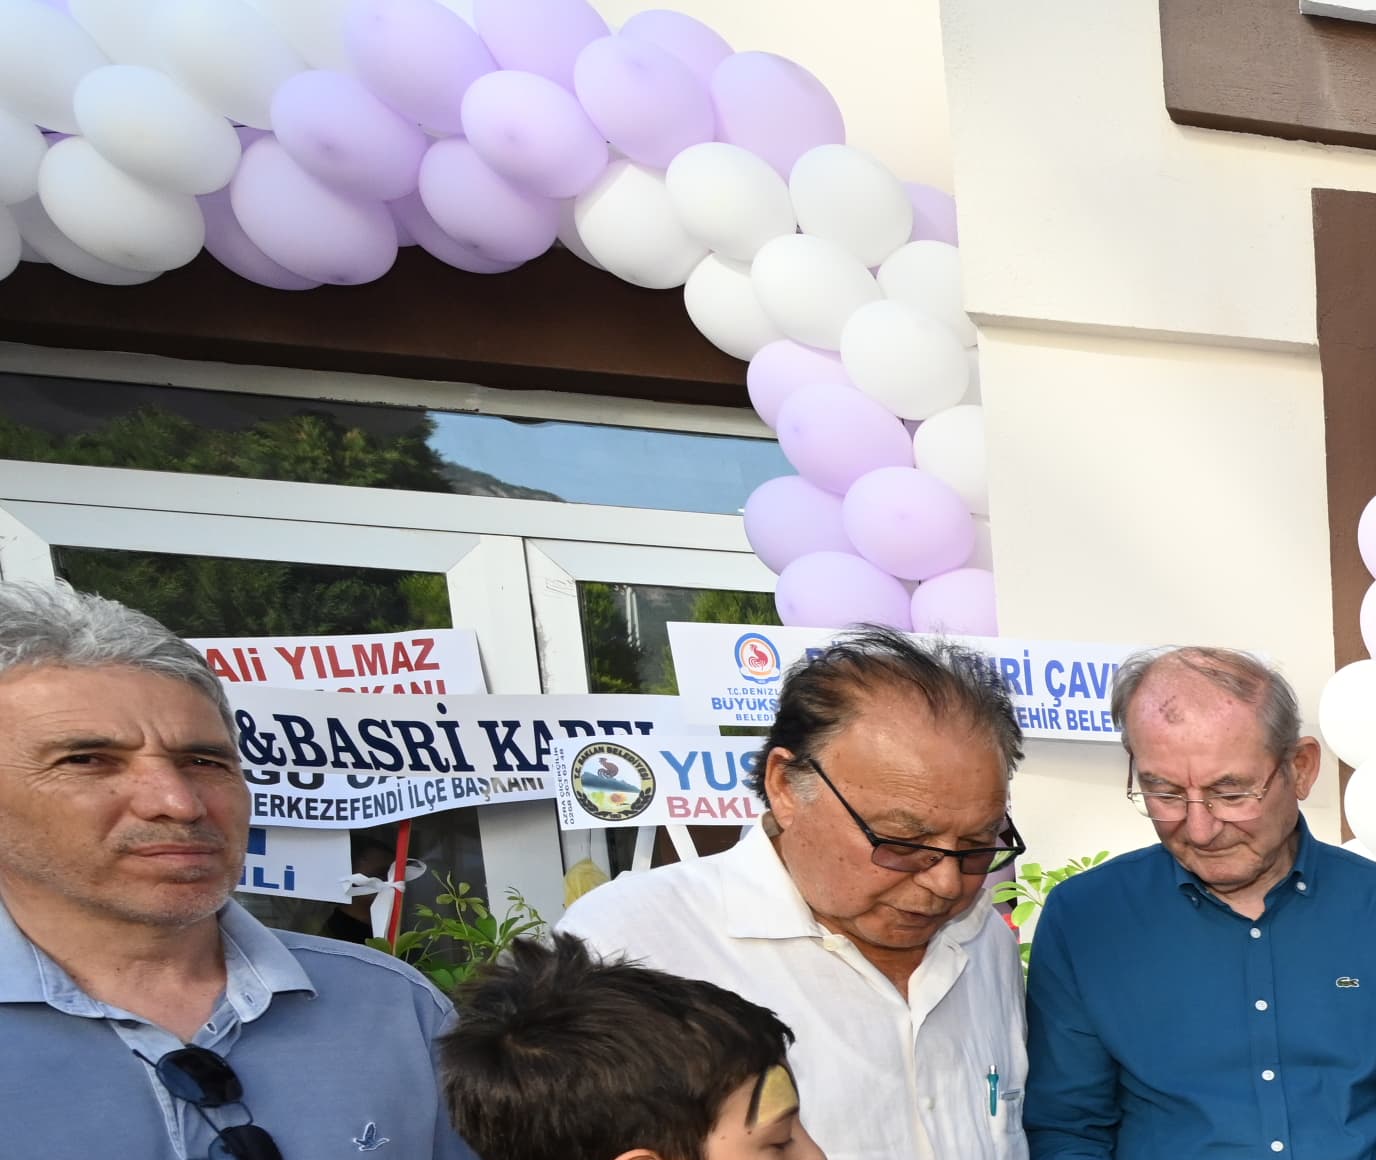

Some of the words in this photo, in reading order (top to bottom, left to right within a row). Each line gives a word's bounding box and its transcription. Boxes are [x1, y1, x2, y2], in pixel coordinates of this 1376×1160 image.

[274, 638, 440, 681] YILMAZ
[1044, 660, 1118, 707] ÇAV
[235, 702, 475, 773] &BASRİ
[1066, 709, 1121, 733] BELE
[407, 778, 447, 811] İLÇE
